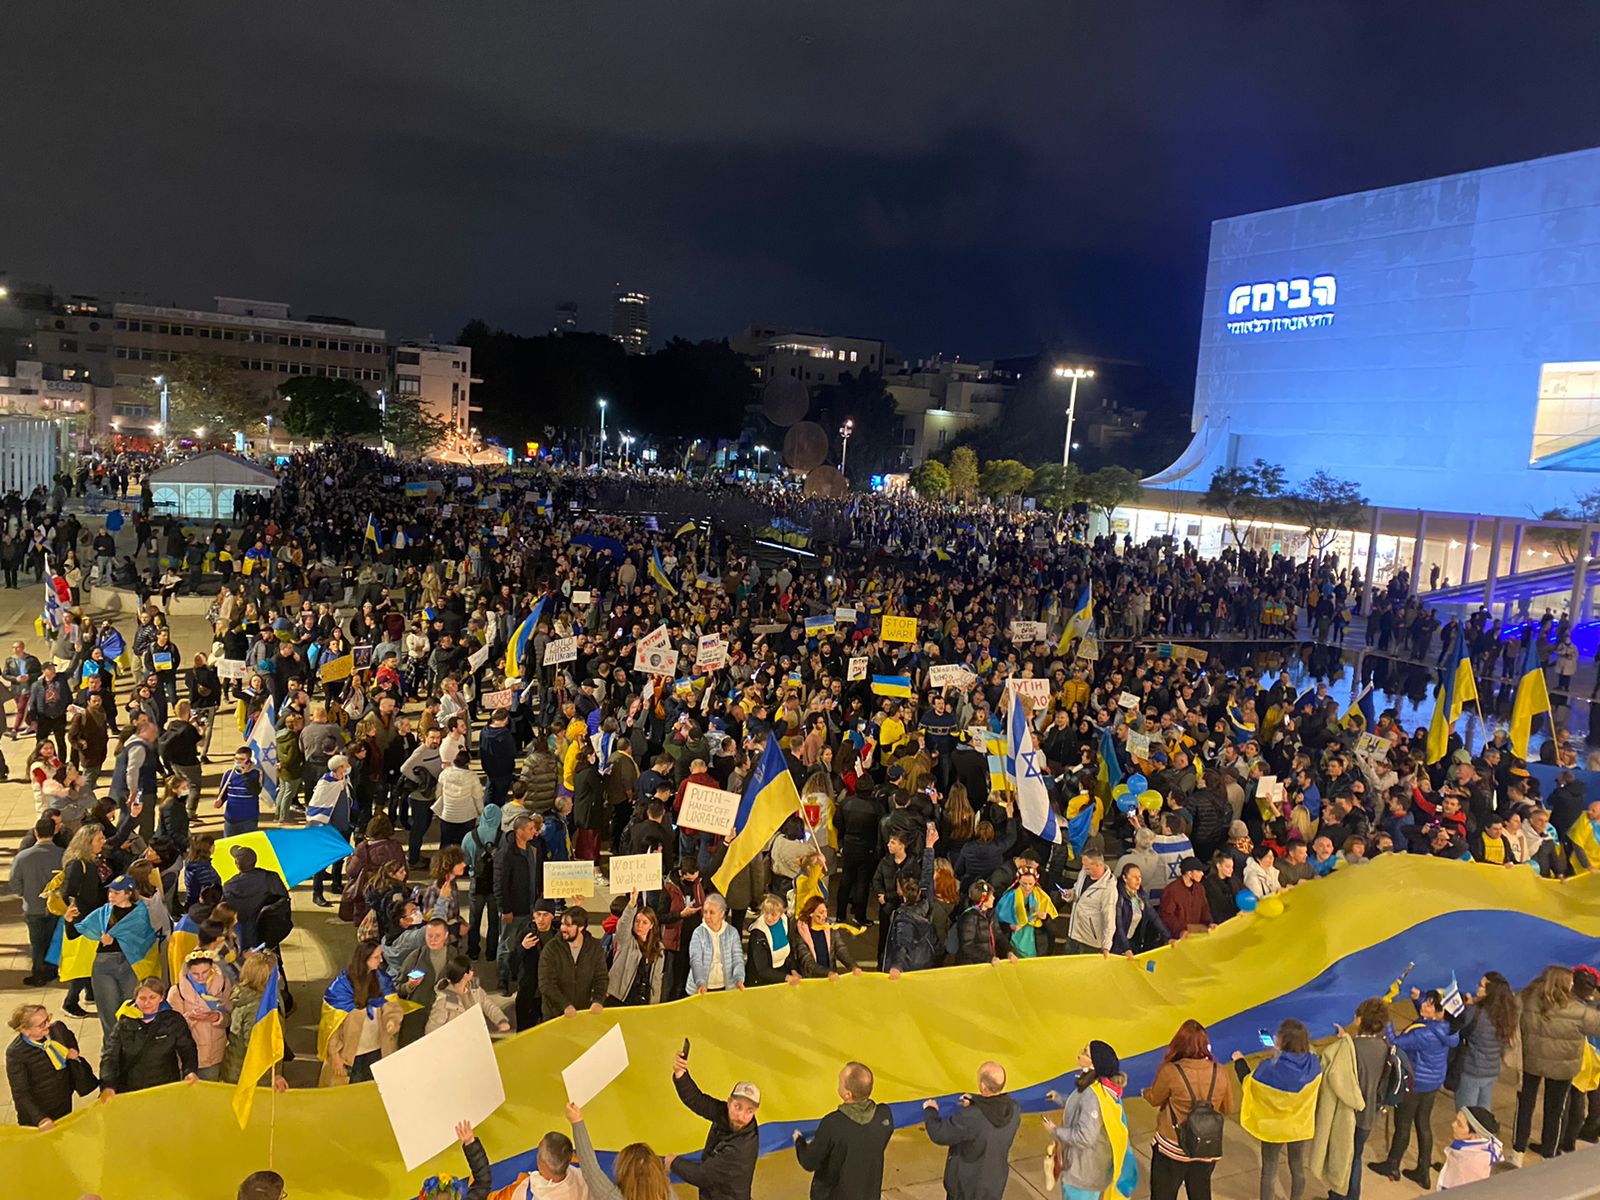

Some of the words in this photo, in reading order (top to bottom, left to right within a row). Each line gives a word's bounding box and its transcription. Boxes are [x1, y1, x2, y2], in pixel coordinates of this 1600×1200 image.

[1228, 275, 1337, 316] הבימה
[885, 618, 913, 628] STOP
[887, 629, 912, 638] WAR!
[690, 787, 722, 802] PUTIN
[688, 801, 713, 813] HANDS
[713, 806, 729, 815] OFF
[686, 811, 730, 827] UKRAINE!
